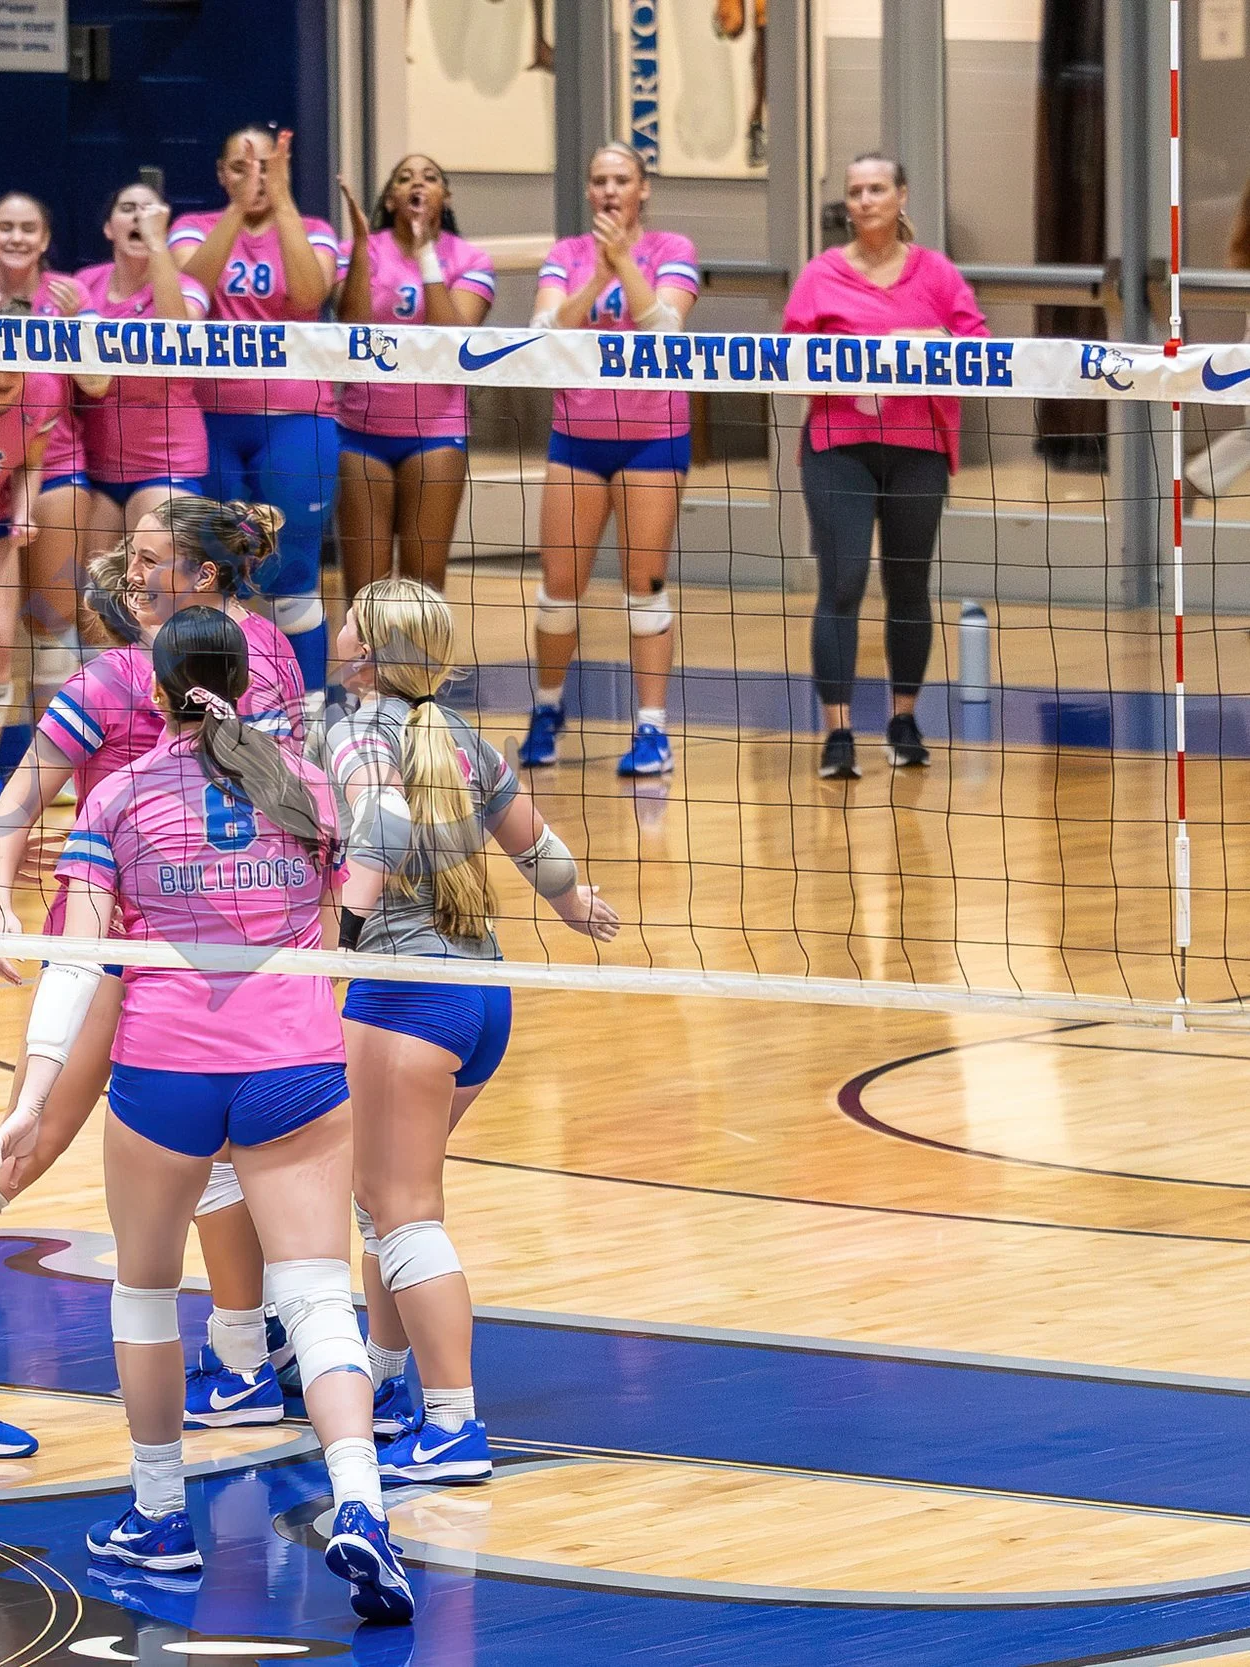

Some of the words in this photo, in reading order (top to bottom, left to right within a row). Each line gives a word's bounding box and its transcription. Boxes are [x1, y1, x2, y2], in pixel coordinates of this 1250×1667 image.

[226, 260, 274, 299] 28
[394, 284, 419, 319] 3
[96, 321, 287, 368] COLLEGE
[598, 334, 791, 382] BARTON
[807, 337, 1015, 388] COLLEGE
[202, 779, 259, 855] 8
[158, 857, 307, 896] BULLDOGS
